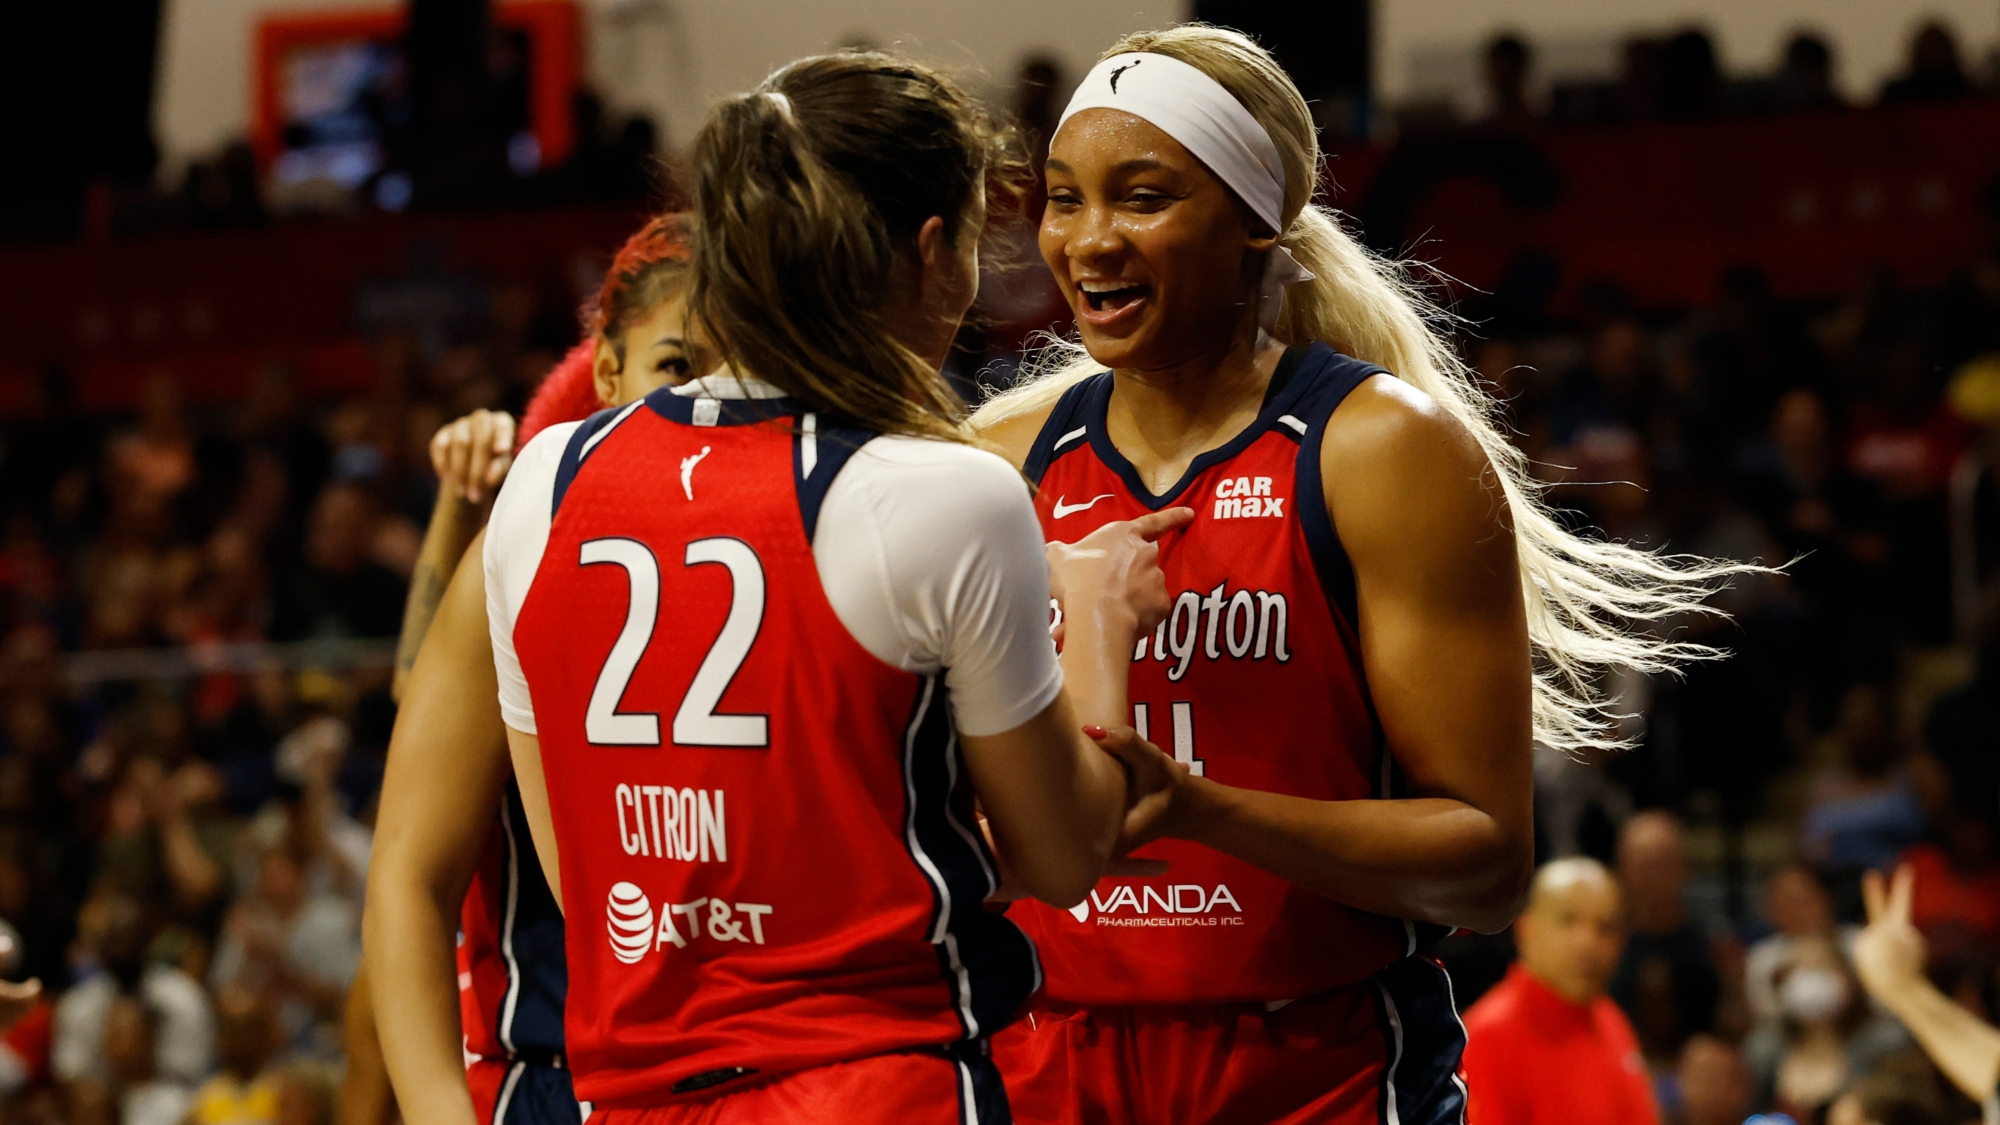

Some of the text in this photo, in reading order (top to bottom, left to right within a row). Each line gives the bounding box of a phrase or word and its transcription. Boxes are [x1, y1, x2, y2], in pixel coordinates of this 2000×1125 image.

[1213, 497, 1285, 520] max
[1215, 476, 1273, 499] CAR
[579, 536, 768, 747] 22
[615, 783, 727, 863] CITRON
[1090, 884, 1242, 913] VANDA
[655, 896, 773, 952] AT&T
